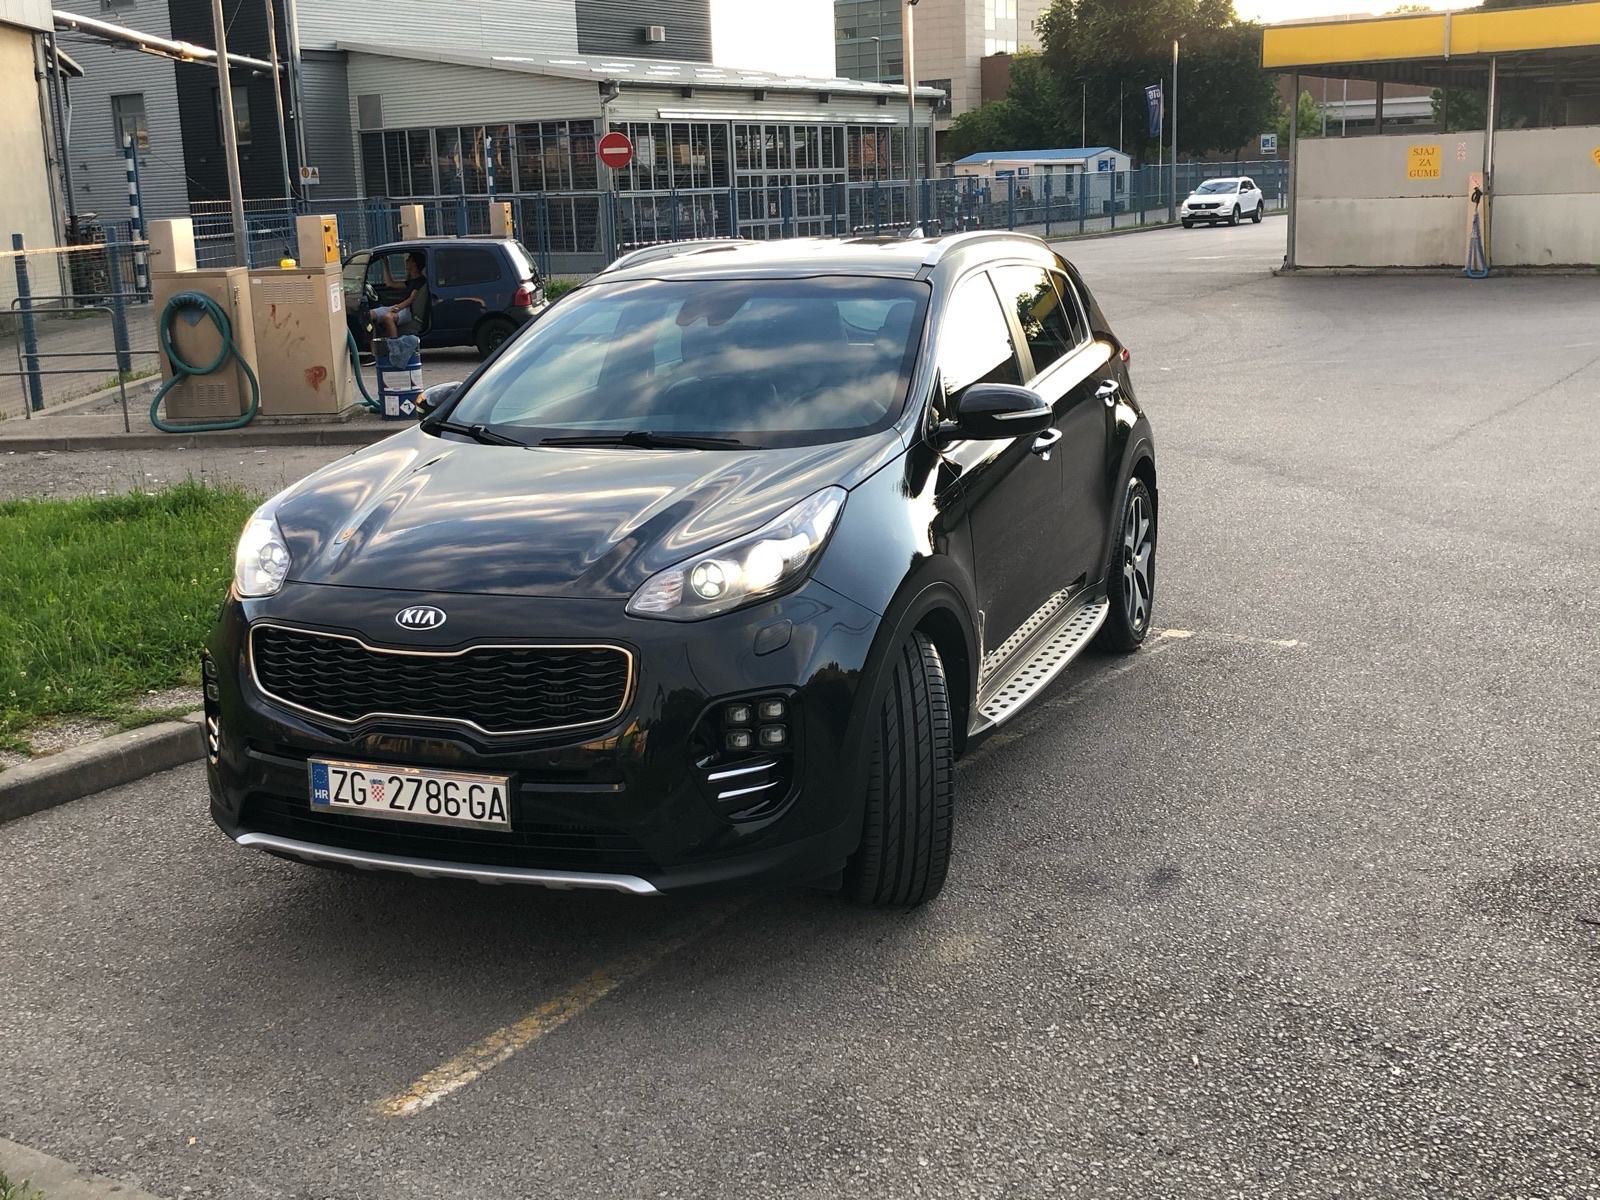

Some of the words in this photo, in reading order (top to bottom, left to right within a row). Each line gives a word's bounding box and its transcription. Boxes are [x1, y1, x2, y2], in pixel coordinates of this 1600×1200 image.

[1413, 147, 1435, 156] SJAJ
[1419, 159, 1432, 167] ZA
[1409, 169, 1440, 178] GUME
[402, 609, 436, 625] KIA
[331, 769, 367, 806] ZG
[314, 788, 329, 800] HR
